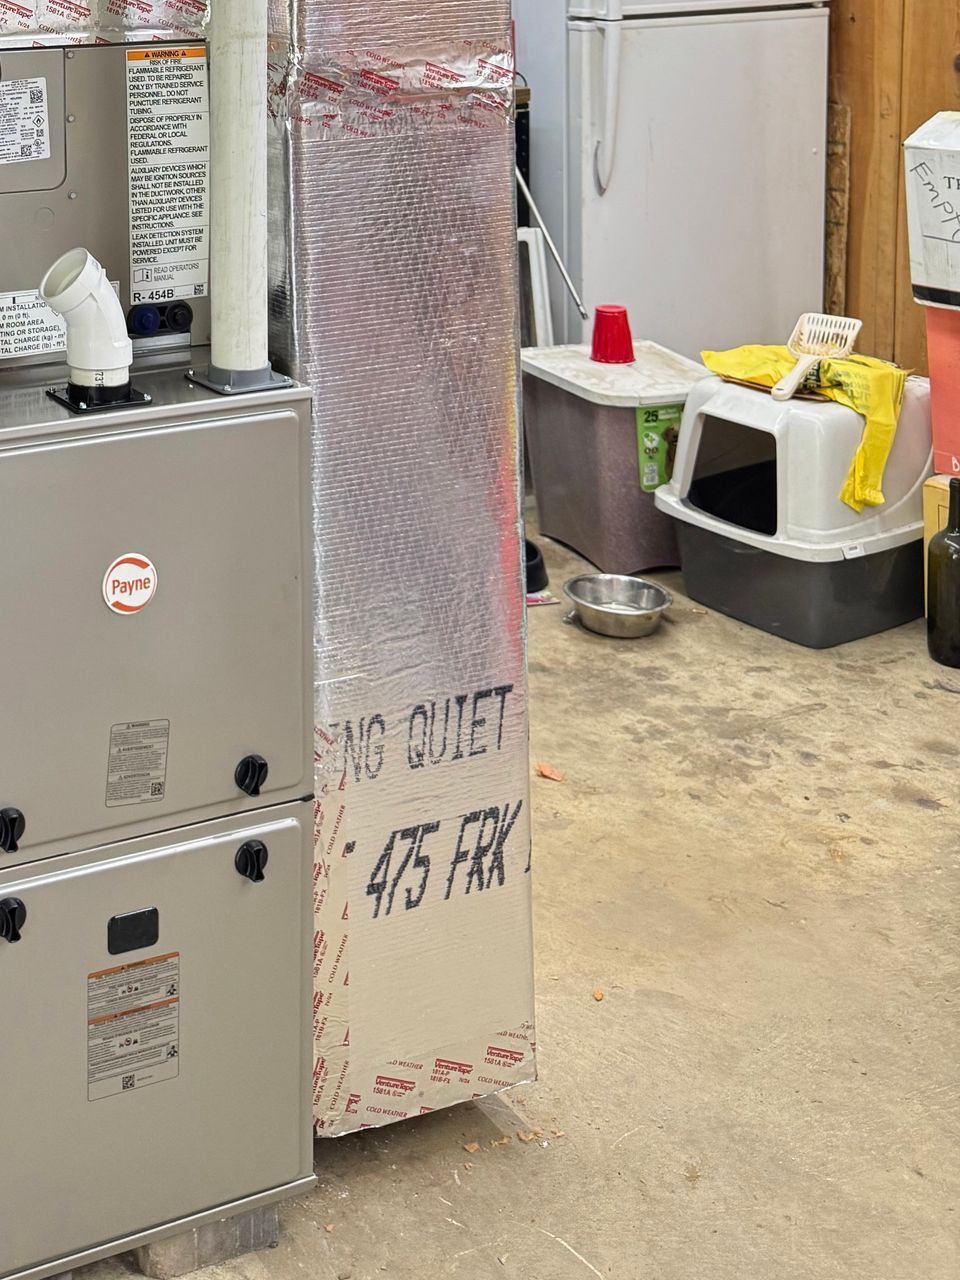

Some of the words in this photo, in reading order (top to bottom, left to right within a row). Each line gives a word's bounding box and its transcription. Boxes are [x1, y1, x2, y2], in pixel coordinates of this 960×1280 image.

[128, 66, 164, 74] FLAMMABLE
[165, 65, 204, 73] REFRIGERANT
[165, 73, 193, 81] REPAIRED
[129, 99, 161, 107] PUNCTURE
[161, 97, 202, 105] REFRIGERANT
[130, 116, 155, 124] DISPOSE
[165, 114, 195, 122] PROPERLY
[130, 123, 171, 132] ACCORDANCE
[130, 132, 157, 140] FEDERAL
[130, 140, 172, 148] REGULATIONS.
[130, 148, 167, 156] FLAMMABLE
[167, 146, 208, 154] REFRIGERANT
[149, 231, 180, 239] DETECTION
[181, 228, 204, 236] SYSTEM
[132, 248, 162, 256] POWERED
[163, 246, 184, 254] EXCEPT
[153, 265, 168, 274] READ
[169, 263, 200, 272] OPERATORS
[153, 274, 175, 282] MANUAL
[6, 301, 47, 312] INSTALLATIO
[26, 318, 45, 326] AREA
[13, 336, 40, 344] CHARGE
[13, 343, 40, 352] CHARGE
[643, 409, 659, 423] 25
[112, 577, 151, 596] Payne
[408, 684, 513, 770] QUIET
[366, 820, 440, 919] 475
[443, 799, 524, 901] FRK
[487, 1047, 525, 1063] VentureTape
[434, 1059, 474, 1075] VentureTape
[375, 1077, 417, 1092] VentureTape
